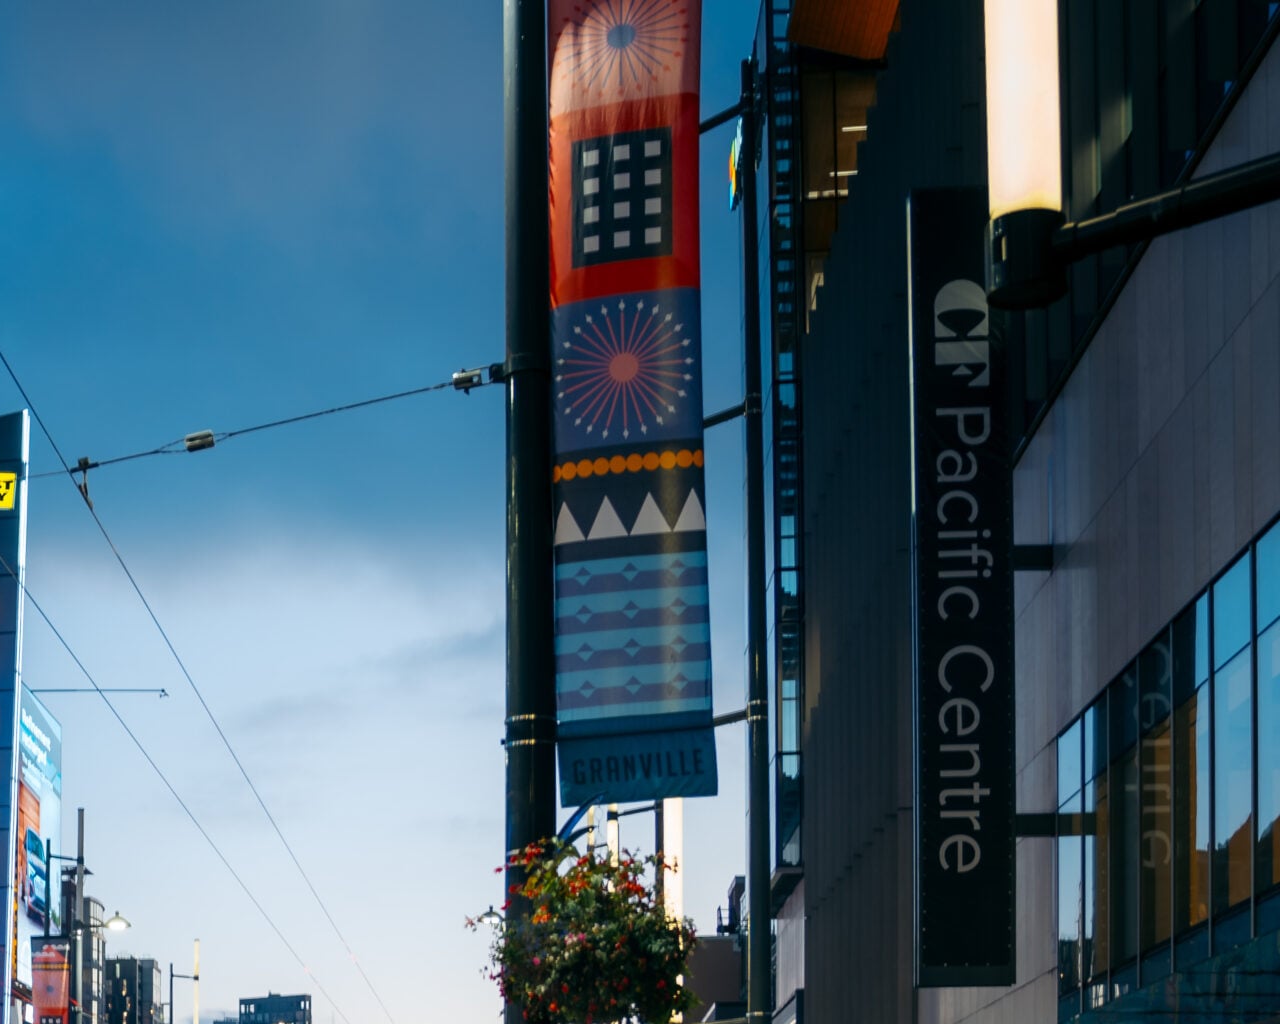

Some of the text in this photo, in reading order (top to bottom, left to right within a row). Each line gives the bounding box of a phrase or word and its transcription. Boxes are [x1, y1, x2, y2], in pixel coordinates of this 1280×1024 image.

[572, 748, 704, 785] GRANVILLE
[936, 406, 995, 875] Pacific Centre
